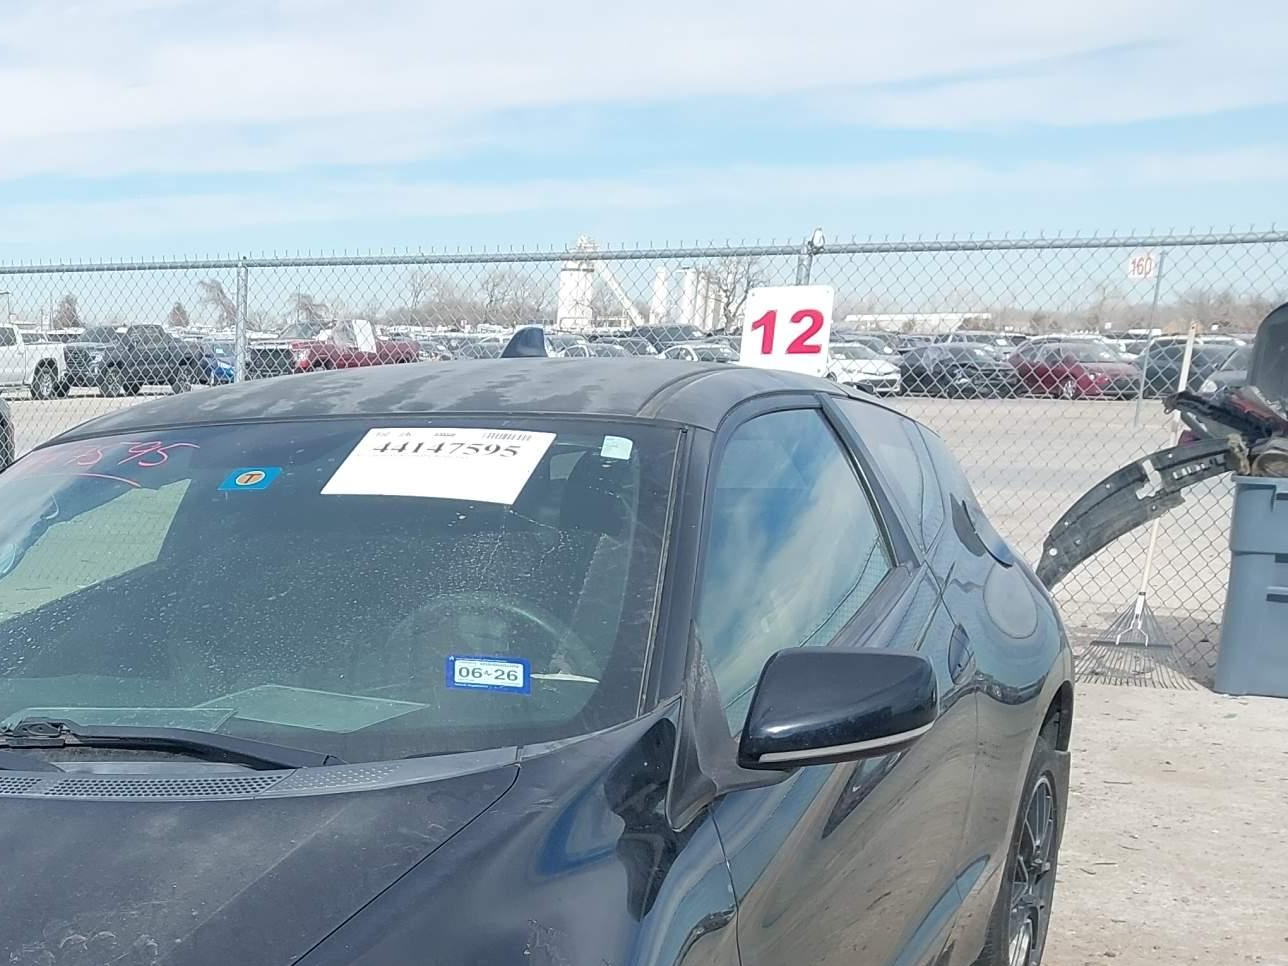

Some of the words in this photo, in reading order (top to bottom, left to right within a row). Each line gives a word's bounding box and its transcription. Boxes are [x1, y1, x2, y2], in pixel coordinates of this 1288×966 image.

[1131, 256, 1152, 275] 160
[751, 309, 824, 355] 12
[372, 441, 521, 458] 44147595
[458, 666, 483, 679] 06
[494, 668, 519, 682] 26
